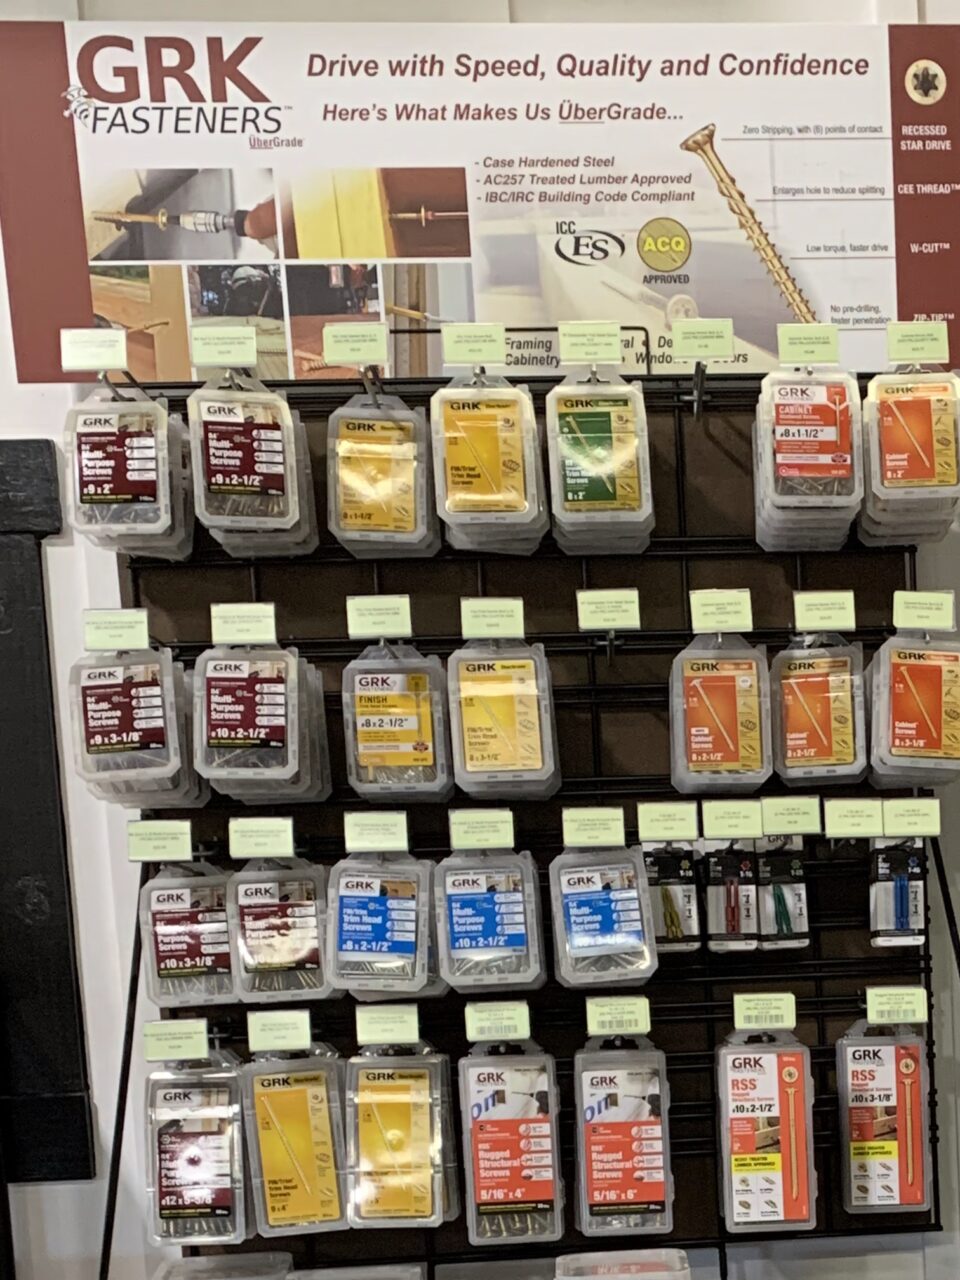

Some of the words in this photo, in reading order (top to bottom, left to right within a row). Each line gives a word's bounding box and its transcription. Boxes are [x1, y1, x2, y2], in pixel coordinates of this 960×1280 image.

[75, 34, 272, 105] GRK
[307, 54, 379, 78] Drive
[387, 52, 445, 77] with
[454, 53, 546, 82] Speed,
[556, 54, 652, 82] Quality
[660, 53, 710, 76] and
[718, 52, 870, 77] Confidence
[322, 103, 388, 122] Here's
[395, 103, 447, 121] What
[452, 103, 518, 122] Makes
[525, 104, 551, 122] Us
[558, 100, 684, 122] ÜberGrade...
[743, 126, 759, 134] Zero
[797, 126, 811, 134] with
[825, 126, 846, 135] points
[848, 125, 855, 133] of
[902, 125, 947, 135] RECESSED
[900, 141, 923, 150] STAR
[925, 140, 951, 150] DRIVE
[483, 157, 515, 168] Case
[519, 157, 579, 168] Hardened
[583, 157, 615, 167] Steel
[484, 175, 524, 186] AC257
[529, 175, 575, 185] Treated
[580, 174, 627, 185] Lumber
[631, 173, 692, 186] Approved
[773, 186, 804, 196] Enlarges
[806, 186, 821, 195] hole
[832, 186, 856, 194] reduce
[858, 185, 885, 196] splitting
[898, 184, 914, 194] CEE
[485, 192, 534, 203] IBC/IRC
[539, 191, 590, 204] Building
[595, 191, 627, 202] Code
[631, 191, 695, 203] Compliant
[556, 221, 576, 235] ICC
[572, 236, 609, 260] ES
[643, 237, 686, 252] ACQ
[807, 244, 821, 252] Low
[824, 245, 847, 253] torque,
[850, 243, 869, 252] faster
[872, 243, 888, 251] drive
[643, 275, 690, 284] APPROVED
[831, 305, 840, 313] No
[850, 316, 892, 324] penetration
[778, 388, 810, 397] GRK
[207, 406, 237, 416] GRK
[450, 401, 481, 411] GRK
[83, 417, 113, 426] GRK
[346, 422, 376, 432] GRK
[213, 664, 243, 672] GRK
[690, 662, 719, 672] GRK
[359, 676, 390, 687] GRK
[359, 696, 387, 704] FINISH
[345, 881, 374, 889] GRK
[452, 878, 480, 888] GRK
[567, 876, 596, 886] GRK
[852, 1049, 882, 1061] GRK
[732, 1057, 763, 1069] GRK
[477, 1073, 505, 1083] GRK
[852, 1070, 876, 1081] RSS
[261, 1077, 291, 1087] GRK
[731, 1079, 757, 1090] RSS
[480, 1189, 507, 1200] 5/16"
